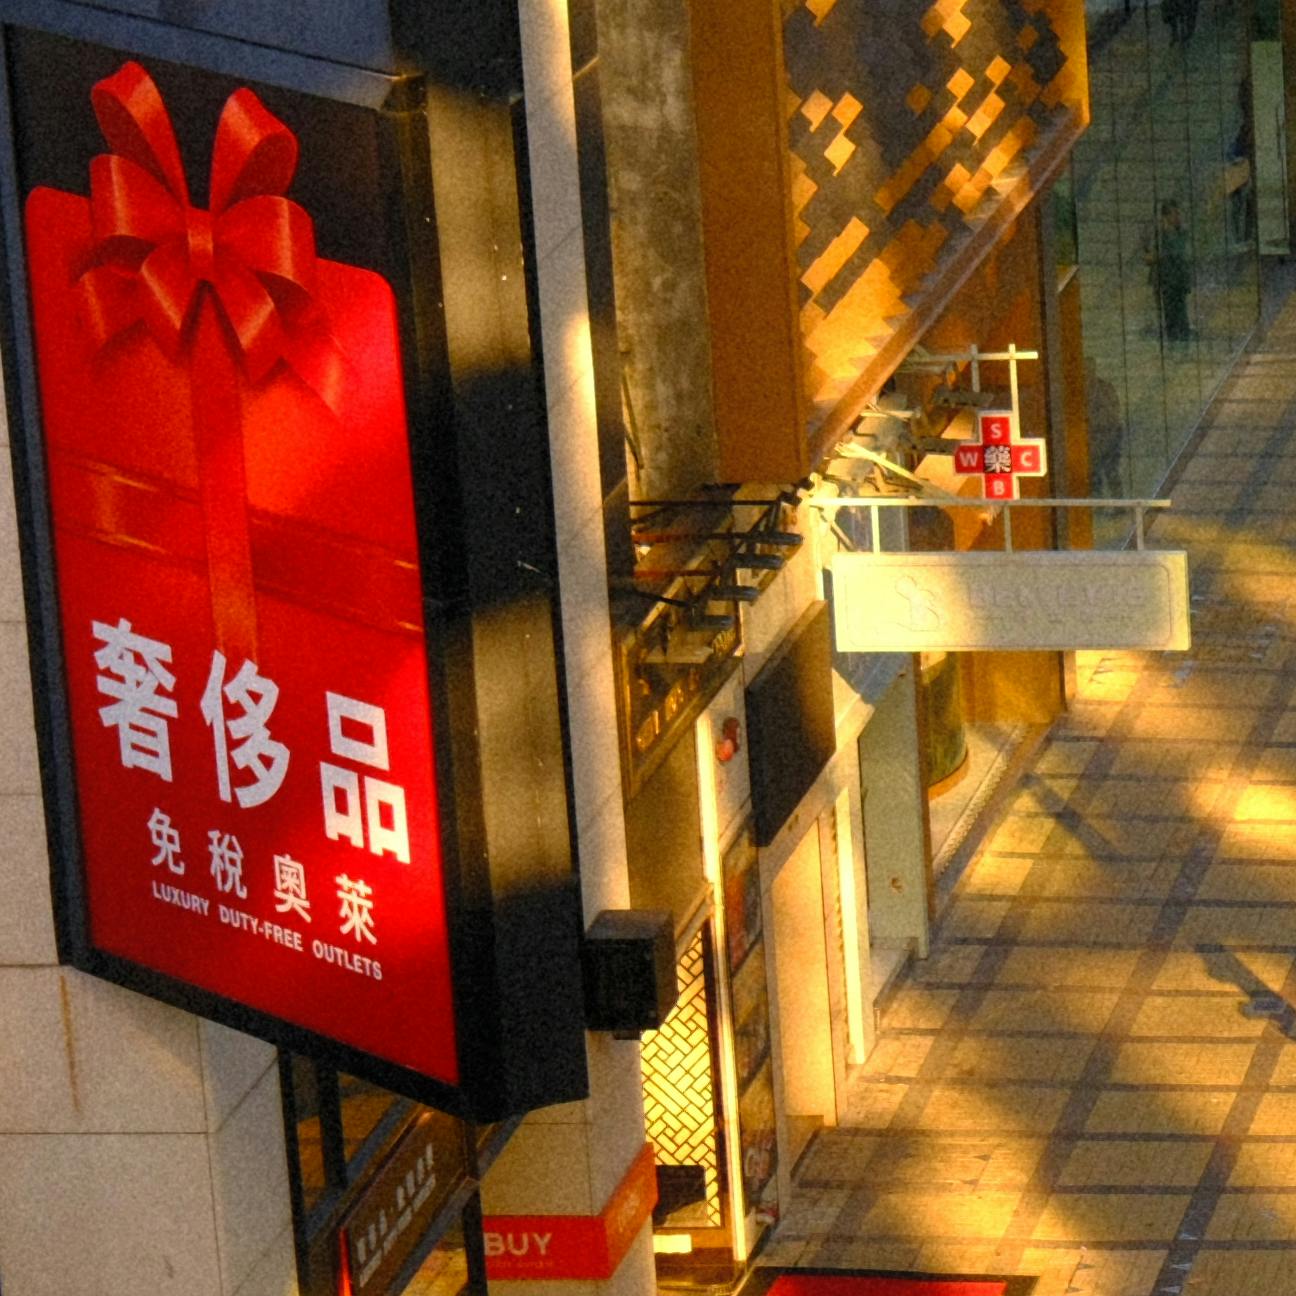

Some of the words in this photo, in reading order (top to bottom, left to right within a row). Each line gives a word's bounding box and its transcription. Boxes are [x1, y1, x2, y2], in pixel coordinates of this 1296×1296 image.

[990, 423, 1002, 438] S
[959, 452, 978, 467] W
[1020, 451, 1033, 467] C
[993, 480, 1005, 496] B
[91, 617, 411, 865] 奢侈品
[151, 880, 210, 917] LUXURY
[218, 903, 304, 953] DUTY-FREE
[312, 939, 383, 982] OUTLETS
